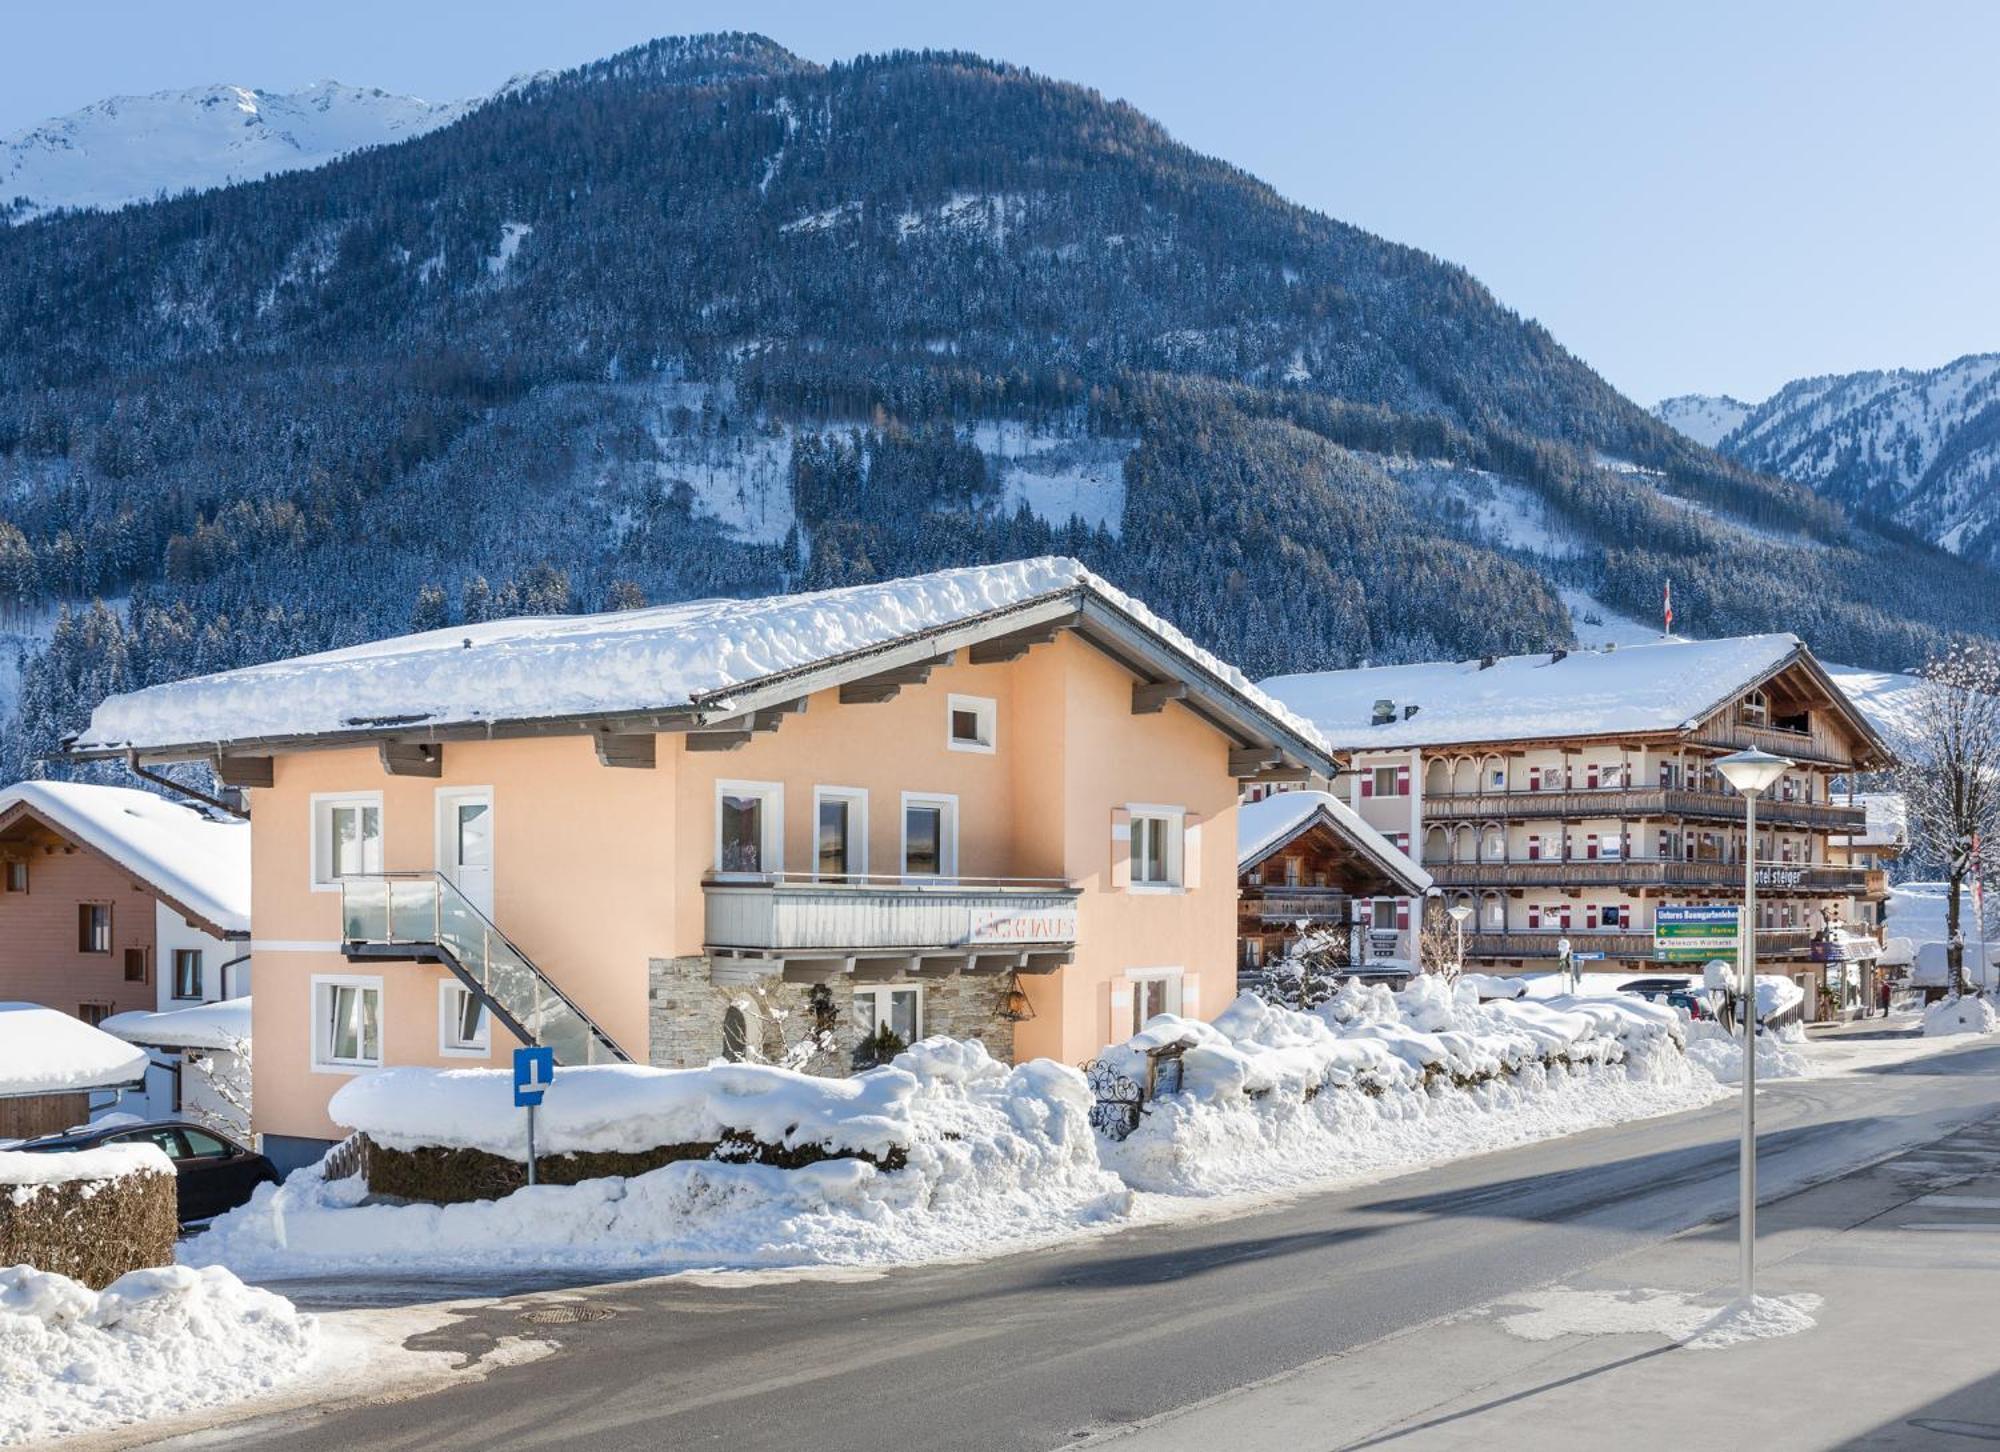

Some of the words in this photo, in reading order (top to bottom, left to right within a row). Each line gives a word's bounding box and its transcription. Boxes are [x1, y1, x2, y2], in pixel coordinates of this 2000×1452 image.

[1754, 867, 1771, 884] otel
[1773, 868, 1800, 887] steiger
[1658, 910, 1683, 920] Unteres
